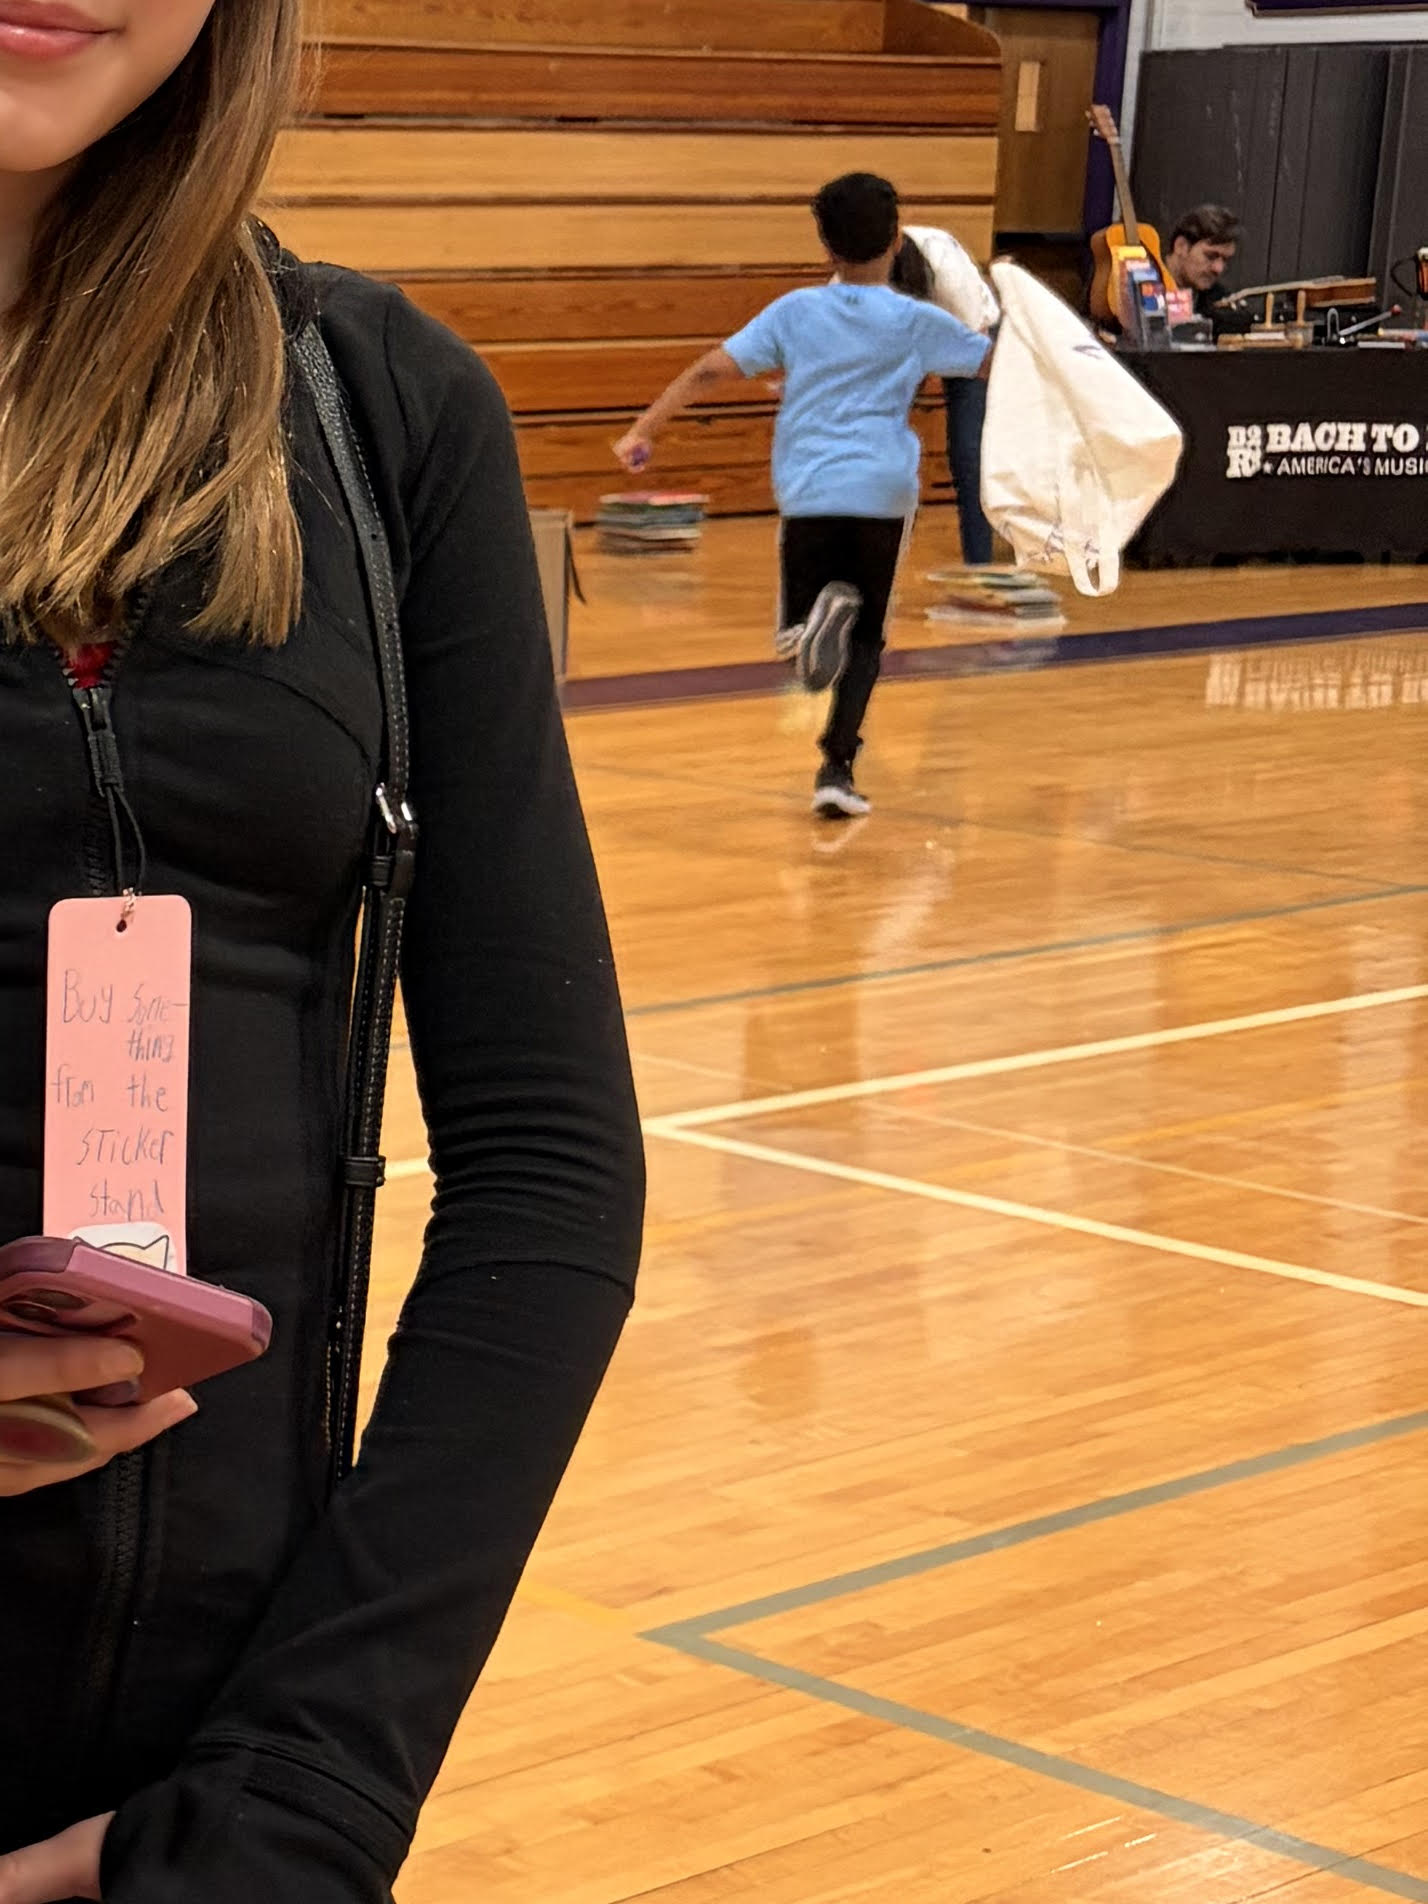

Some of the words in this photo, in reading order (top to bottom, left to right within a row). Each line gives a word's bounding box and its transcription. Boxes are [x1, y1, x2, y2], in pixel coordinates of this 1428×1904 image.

[1266, 422, 1367, 452] BACH
[1371, 423, 1419, 452] TO
[1277, 456, 1371, 476] AMERICA'S
[1374, 457, 1428, 476] MUSI
[63, 968, 114, 1025] Buy
[125, 1074, 169, 1113] the
